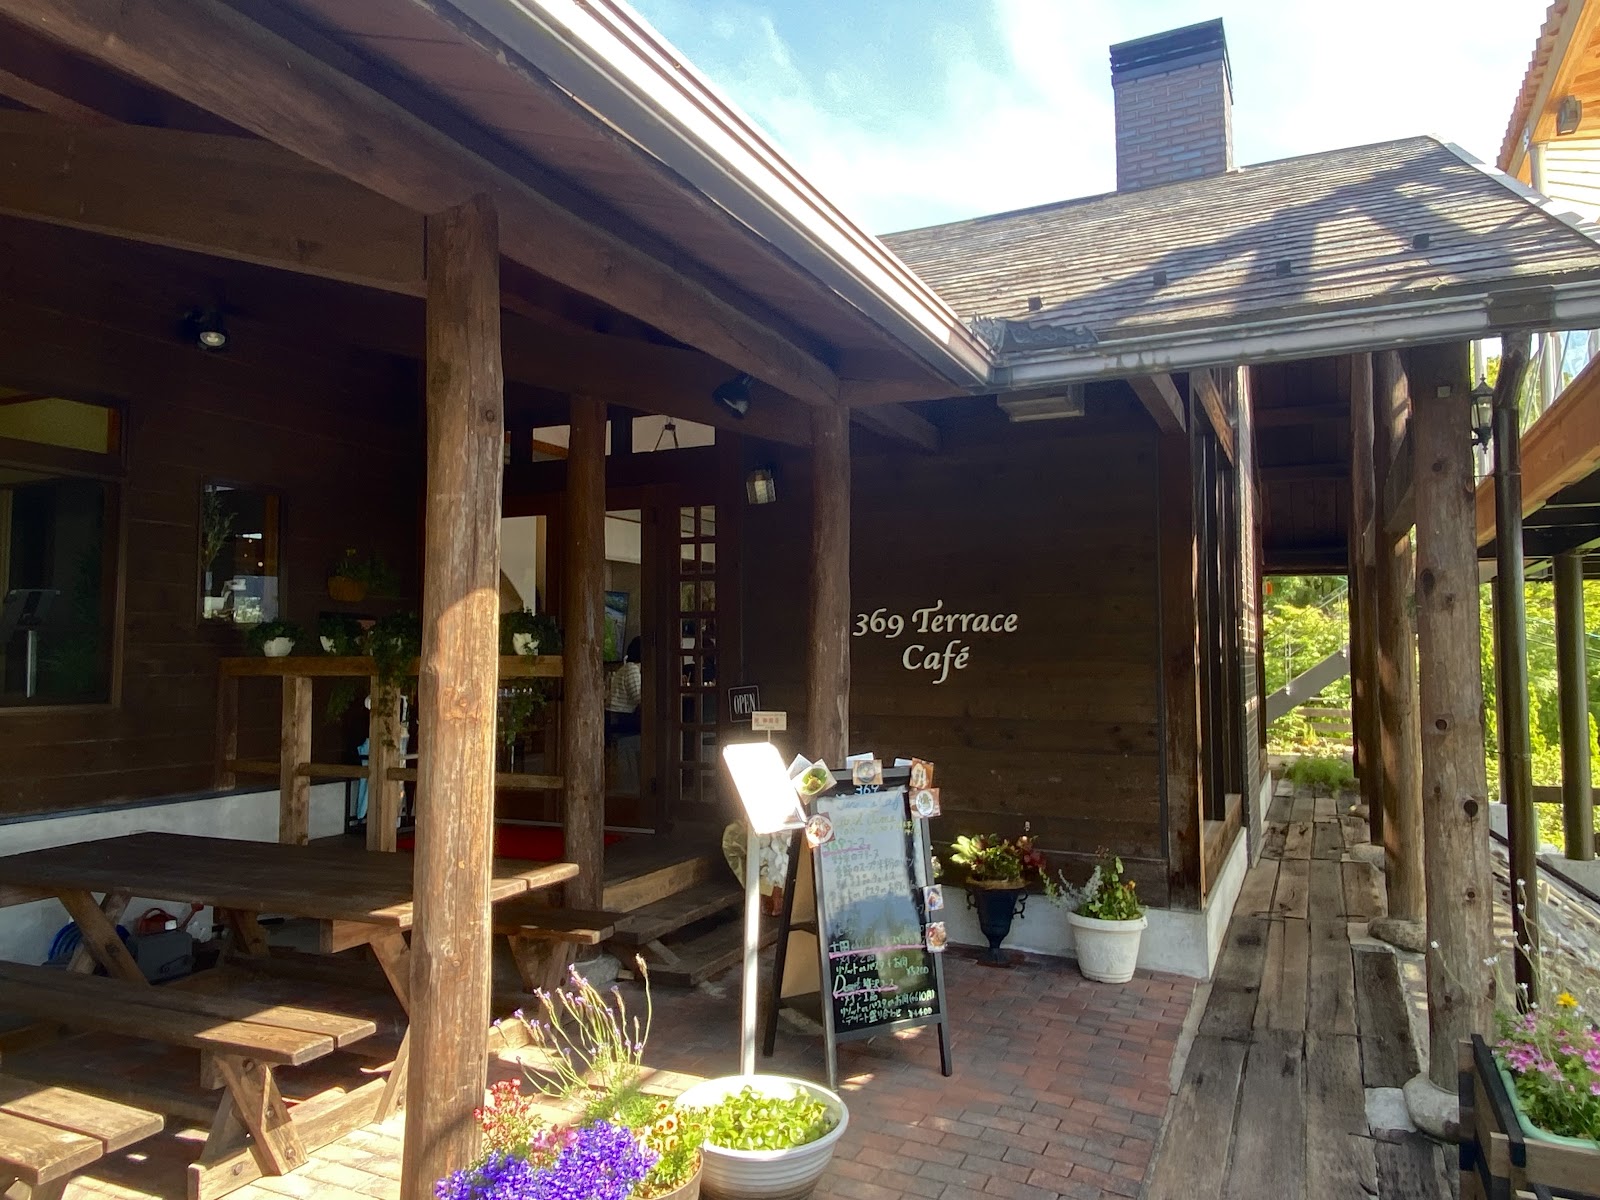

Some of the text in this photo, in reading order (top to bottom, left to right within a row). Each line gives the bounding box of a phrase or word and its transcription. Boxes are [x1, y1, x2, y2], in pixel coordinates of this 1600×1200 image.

[852, 599, 1018, 638] 369 Terrace
[902, 639, 970, 684] Café
[733, 693, 756, 714] OPEN
